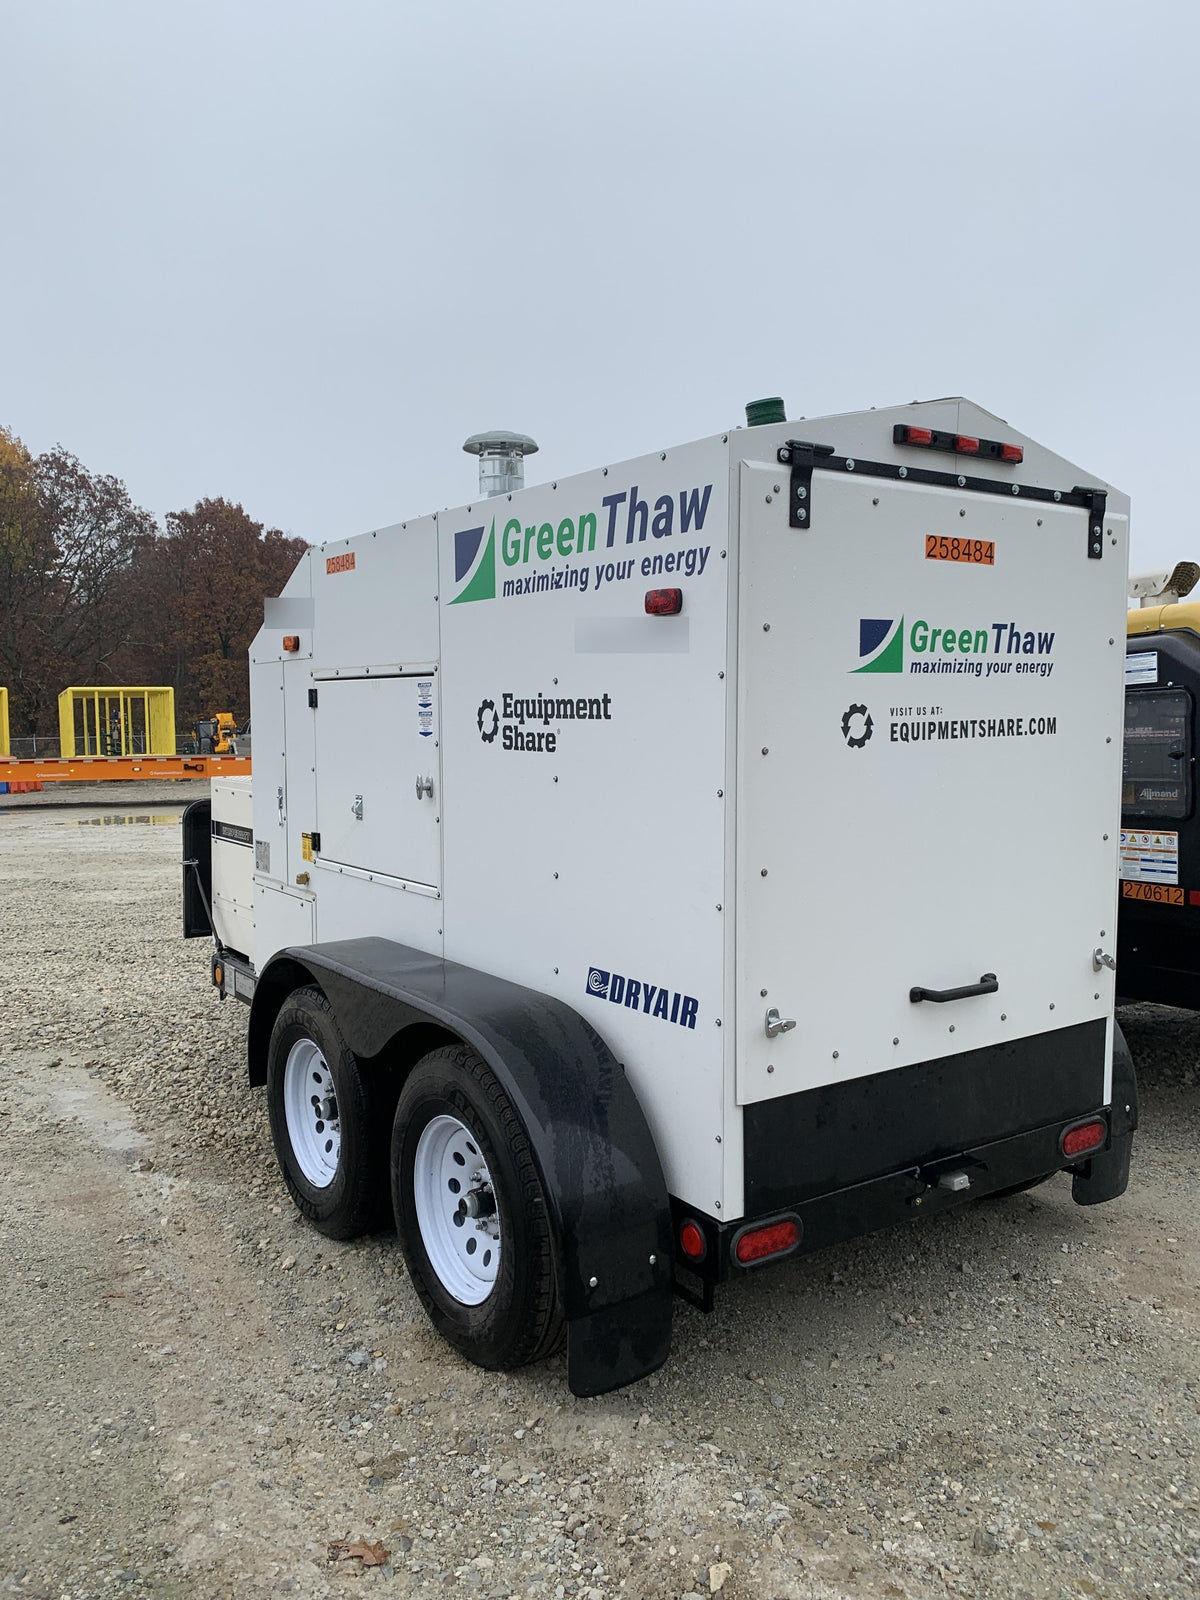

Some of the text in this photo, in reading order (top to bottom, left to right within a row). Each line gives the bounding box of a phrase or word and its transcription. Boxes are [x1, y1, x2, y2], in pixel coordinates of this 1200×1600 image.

[502, 484, 713, 567] GreenThaw
[927, 535, 994, 563] 258484
[326, 553, 355, 574] 258484
[502, 546, 711, 597] maximizing your energy
[910, 620, 1055, 654] GreenThaw
[910, 658, 1054, 677] maximizing your energy
[502, 692, 612, 725] Equipment
[890, 706, 943, 716] VISIT US AT:
[502, 725, 557, 753] Share
[890, 717, 1057, 743] EQUIPMENTSHARE.COM
[1124, 882, 1183, 904] 270612
[609, 973, 699, 1030] DRYAIR
